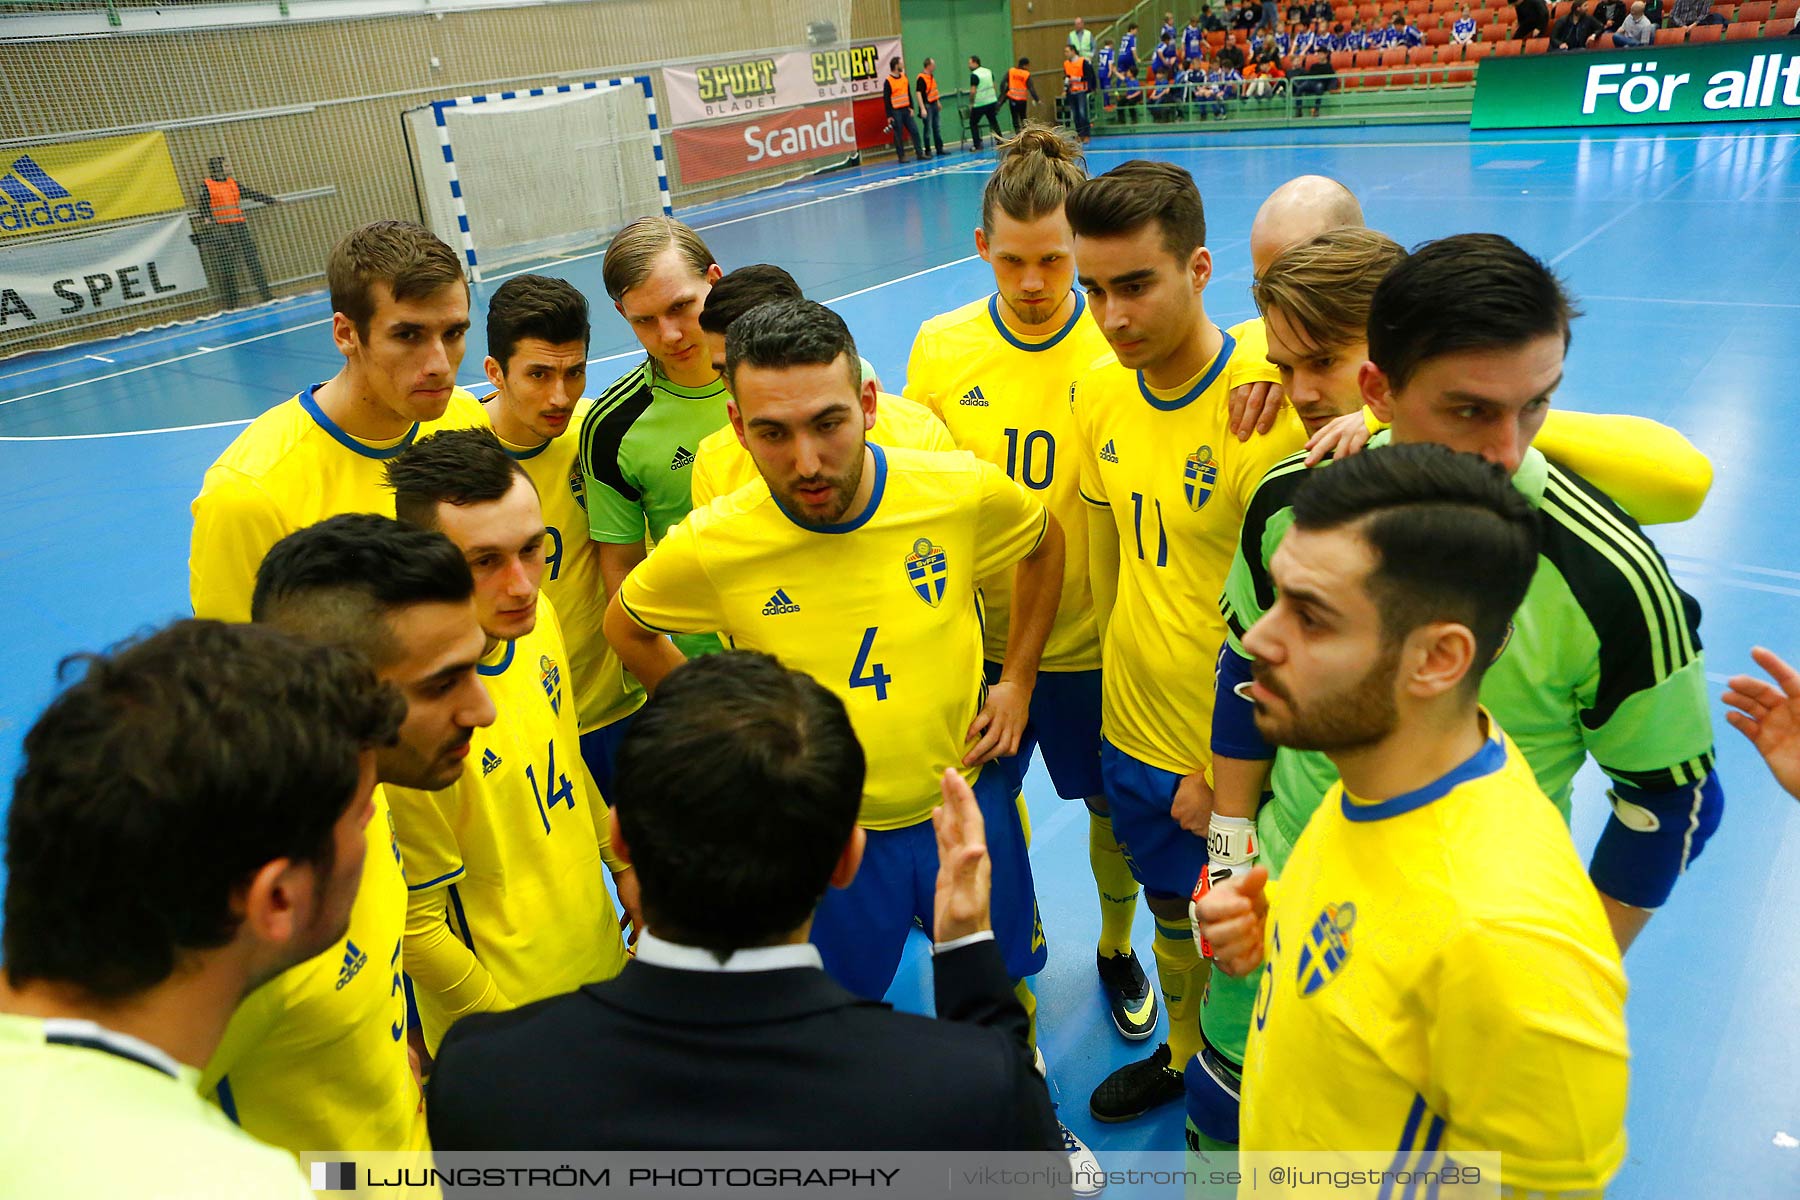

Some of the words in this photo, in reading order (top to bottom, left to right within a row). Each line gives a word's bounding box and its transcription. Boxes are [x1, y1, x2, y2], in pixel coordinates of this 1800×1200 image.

[695, 59, 777, 103] SPORT
[811, 45, 878, 86] SPORT
[706, 98, 776, 115] BLADET
[819, 80, 879, 97] BLADET
[1582, 61, 1690, 114] För
[744, 109, 856, 162] Scandic
[0, 201, 95, 231] didas
[53, 261, 177, 315] SPEL
[959, 397, 989, 408] adidas
[670, 454, 697, 471] adida
[1004, 427, 1056, 490] 10
[1131, 491, 1168, 567] 11
[761, 603, 801, 617] adidas
[848, 626, 892, 702] 4
[525, 738, 576, 836] 14
[335, 952, 368, 991] adidas
